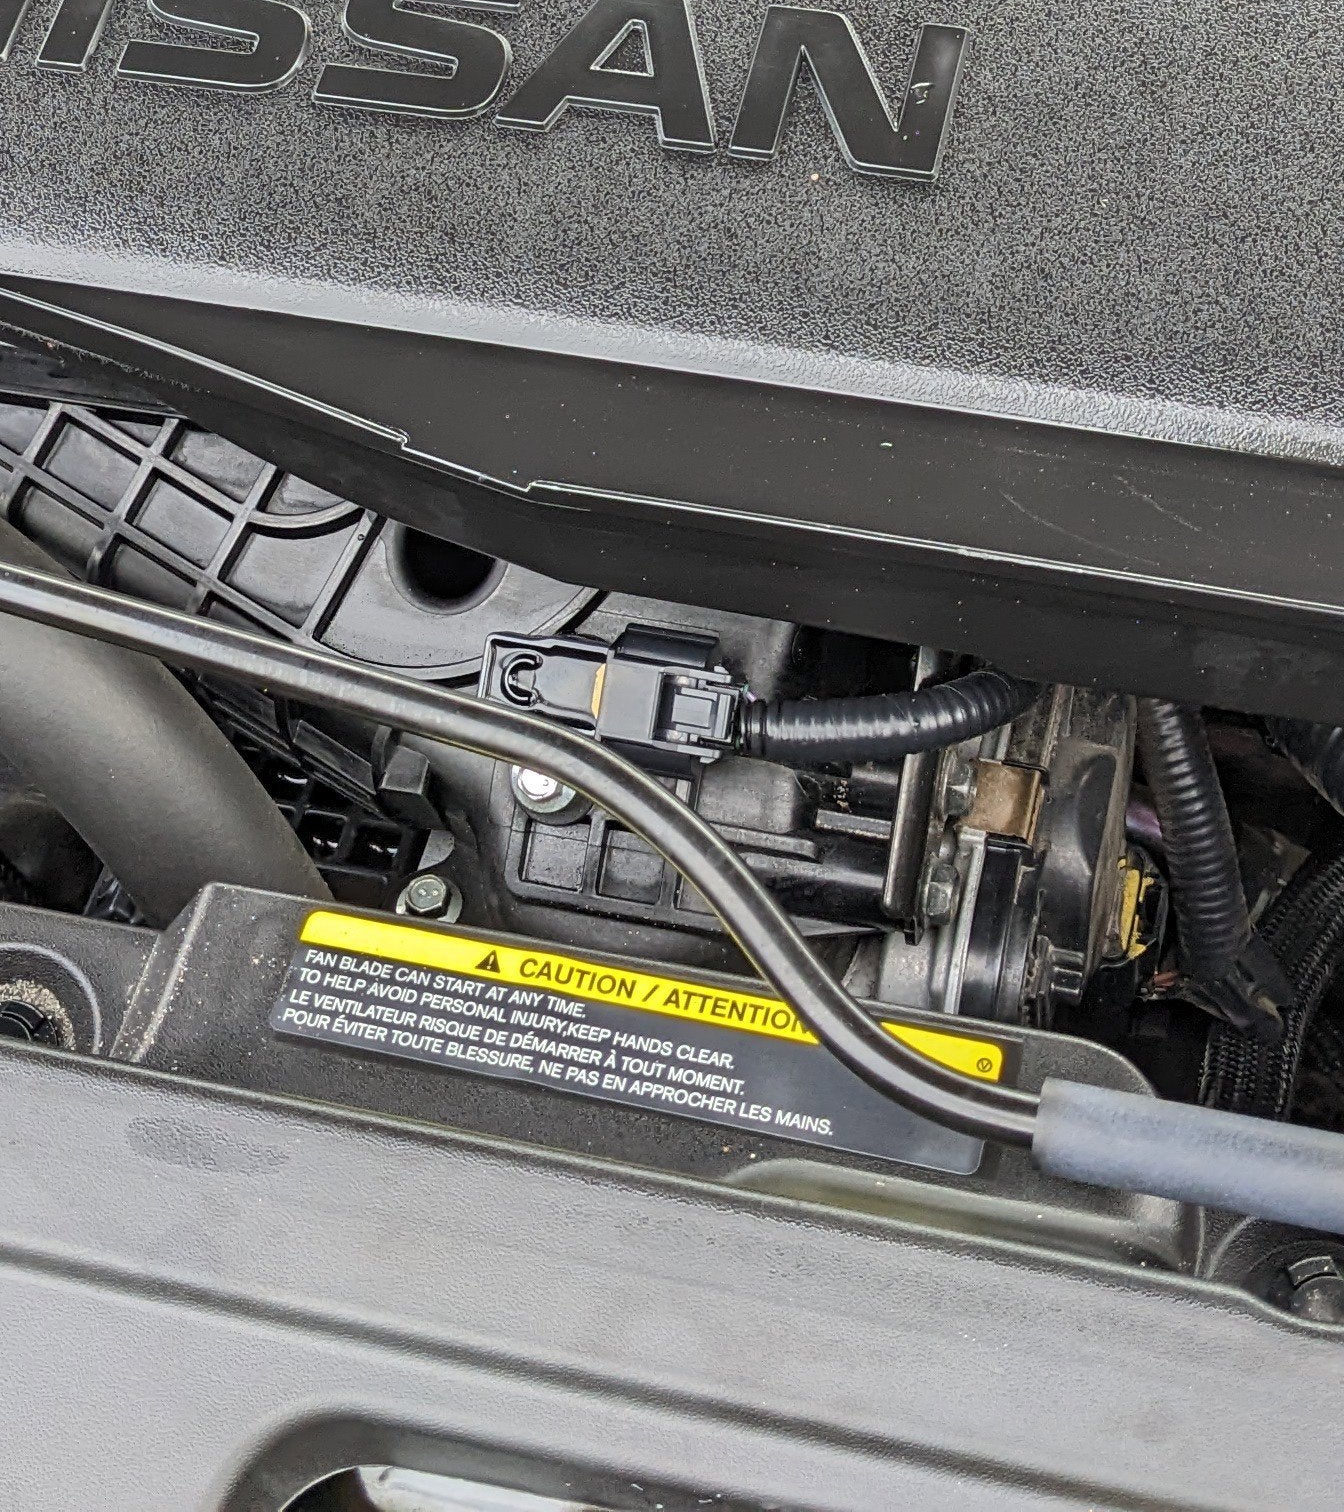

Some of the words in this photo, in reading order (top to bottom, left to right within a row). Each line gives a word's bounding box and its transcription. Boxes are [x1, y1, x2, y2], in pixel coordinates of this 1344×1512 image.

[299, 966, 321, 984] TO
[323, 971, 367, 992] HELP
[367, 982, 417, 1004] AVOID
[419, 993, 508, 1023] PERSONAL
[613, 1031, 674, 1057] HANDS
[676, 1044, 735, 1070] CLEAR.
[305, 949, 338, 969] FAN
[339, 955, 392, 979] BLADE
[395, 967, 430, 987] CAN
[432, 974, 482, 997] START
[484, 985, 508, 1002] AT
[508, 989, 546, 1010] ANY
[547, 994, 586, 1019] TIME.
[519, 957, 637, 1000] CAUTION
[282, 1008, 329, 1030] POUR
[332, 1014, 388, 1042] ÉVITER
[391, 1029, 443, 1054] TOUTE
[445, 1042, 535, 1074] BLESSURE,
[538, 1059, 562, 1078] NE
[565, 1066, 599, 1086] PAS
[601, 1073, 626, 1092] EN
[628, 1079, 737, 1115] APPROCHER
[738, 1102, 773, 1123] LES
[775, 1109, 834, 1136] MAINS.
[289, 988, 311, 1005] LE
[313, 993, 417, 1028] VENTILATEUR
[418, 1016, 481, 1041] RISQUE
[483, 1029, 509, 1047] DE
[509, 1031, 602, 1066] DÉMARRER
[603, 1049, 618, 1069] À
[621, 1056, 665, 1078] TOUT
[666, 1067, 745, 1096] MOMENT.
